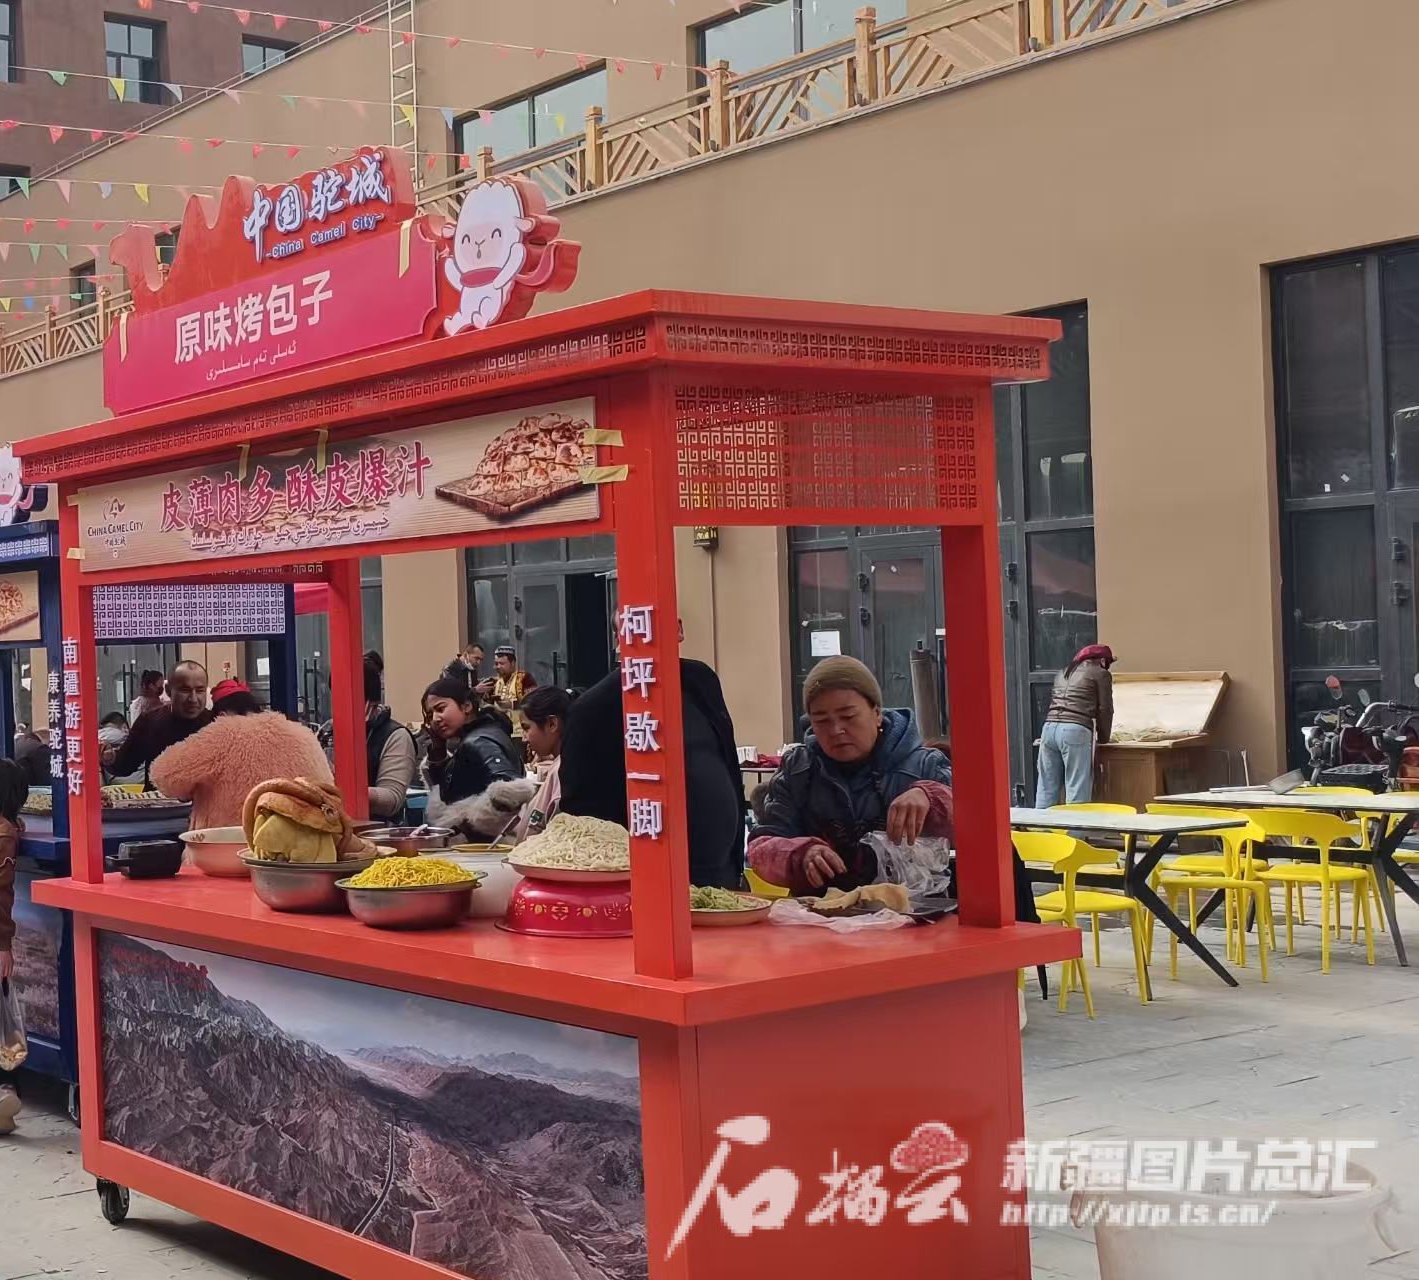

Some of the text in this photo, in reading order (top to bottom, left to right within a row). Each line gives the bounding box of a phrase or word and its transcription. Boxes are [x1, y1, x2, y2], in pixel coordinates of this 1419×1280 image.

[243, 151, 391, 262] 中国驼城
[310, 221, 346, 246] Camel
[174, 270, 333, 365] 原味烤包子
[159, 439, 432, 533] 皮薄肉多 酥皮爆汁
[48, 671, 64, 778] 康养驼城
[62, 637, 84, 796] 南疆游更好
[619, 604, 663, 840] 柯坪歇一脚
